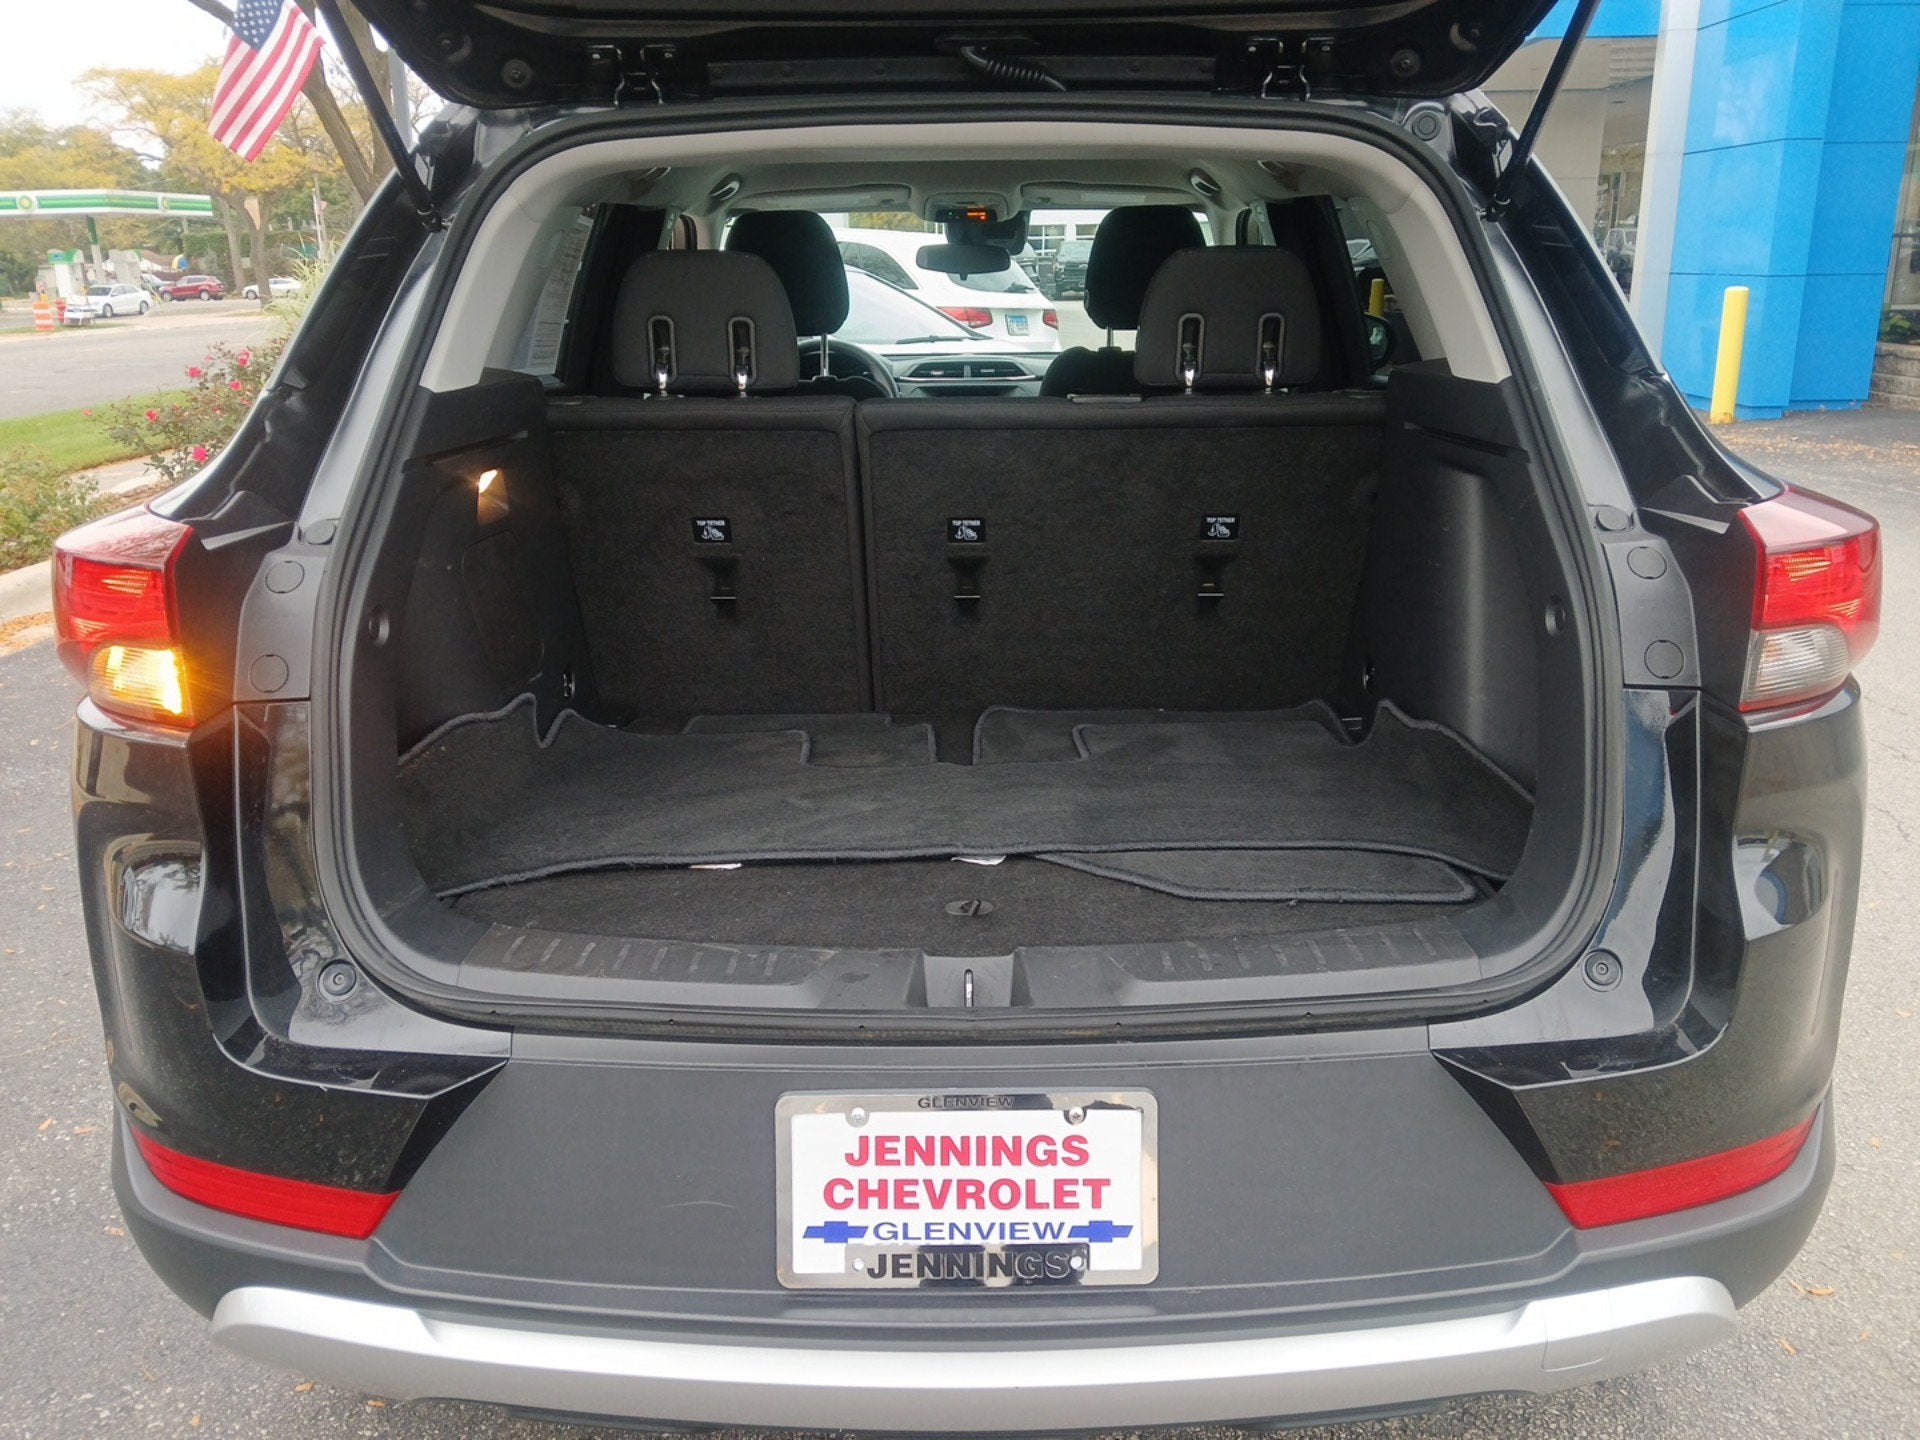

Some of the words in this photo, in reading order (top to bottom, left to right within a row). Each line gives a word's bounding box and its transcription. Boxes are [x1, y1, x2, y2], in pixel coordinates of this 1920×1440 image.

[917, 1095, 1015, 1109] GLENVIEW
[844, 1135, 1089, 1167] JENNINGS
[823, 1178, 1111, 1210] CHEVROLET
[872, 1221, 1066, 1241] GLENVIEW
[867, 1251, 1071, 1280] JENNINGS
